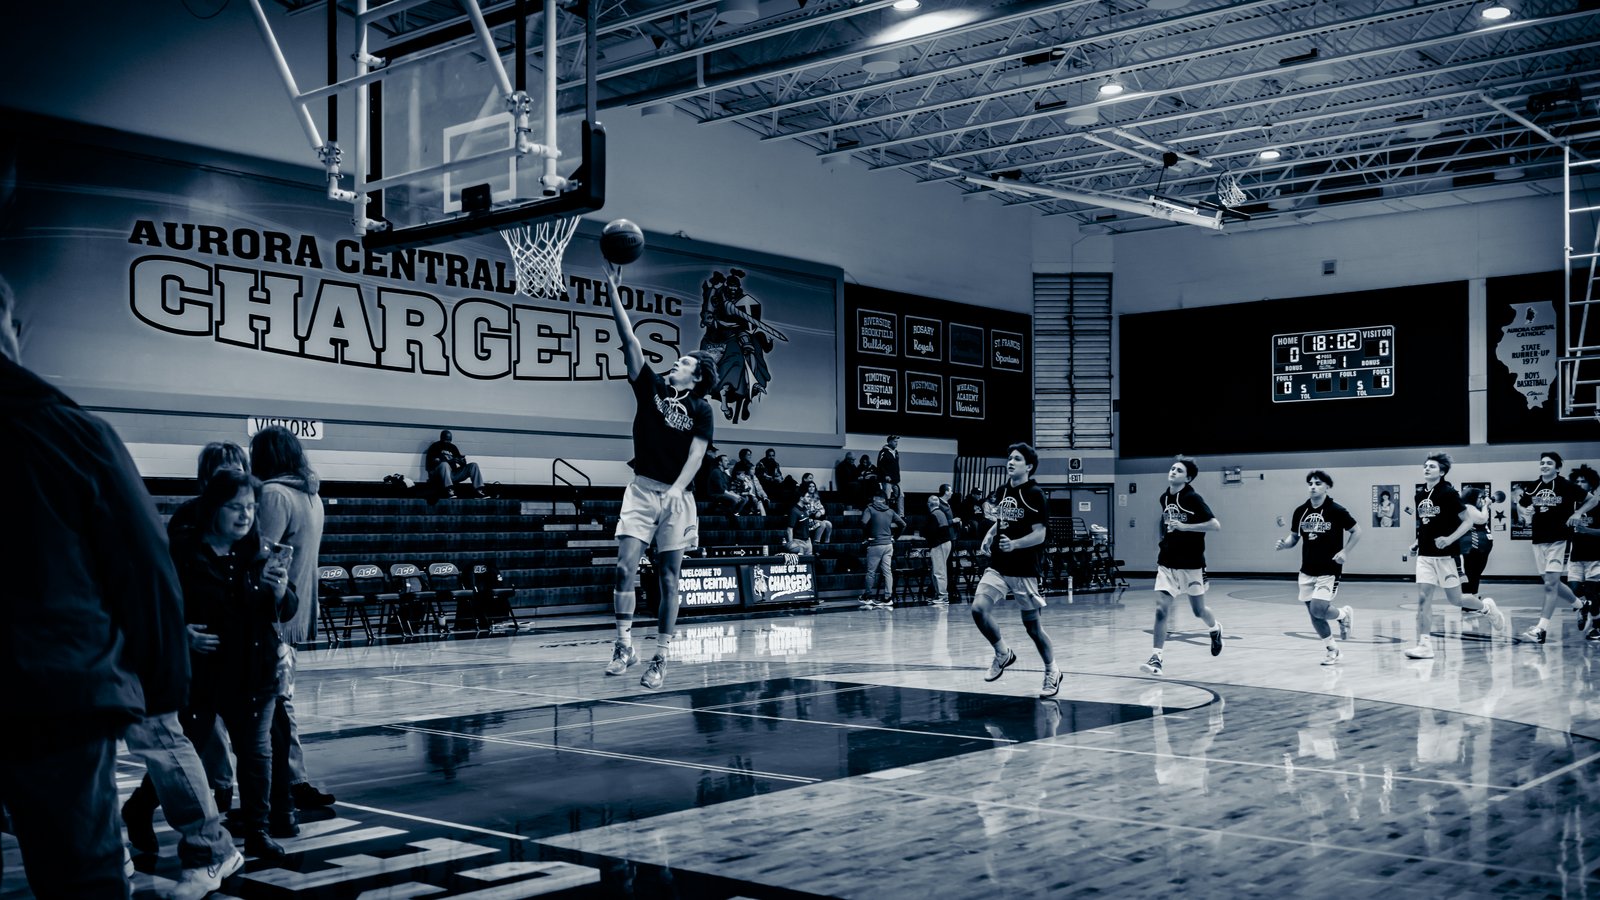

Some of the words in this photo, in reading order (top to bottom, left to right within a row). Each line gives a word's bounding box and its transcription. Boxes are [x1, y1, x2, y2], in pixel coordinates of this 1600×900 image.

[128, 219, 322, 269] AURORA
[336, 239, 516, 294] CENTRAL
[527, 267, 682, 316] CATHOLIC
[129, 254, 681, 381] CHARGERS
[864, 317, 891, 329] RIVERSIDE
[861, 327, 893, 339] BROOKFIELD
[913, 325, 934, 335] ROSARY
[1363, 329, 1392, 338] VISITOR
[863, 337, 892, 354] Bulldogs
[913, 339, 934, 354] Royals
[1002, 339, 1020, 350] FRANCIS
[1278, 337, 1298, 345] HOME
[1312, 333, 1356, 351] 18:02
[1379, 340, 1389, 356] 0
[996, 351, 1019, 364] Spartans
[1290, 347, 1299, 362] 0
[1512, 350, 1550, 358] RUNNER-UP
[865, 373, 890, 383] TIMOTHY
[1381, 375, 1389, 388] 0
[1517, 379, 1547, 387] BASKETBALL
[863, 384, 893, 394] CHRISTIAN
[911, 381, 938, 392] WESTMONT
[1284, 382, 1292, 394] 0
[865, 393, 891, 409] Trojans
[957, 393, 979, 401] ACADEMY
[321, 569, 343, 578] ACC
[357, 567, 378, 577] ACC
[395, 566, 415, 576] ACC
[434, 566, 453, 574] ACC
[474, 565, 487, 573] AC
[681, 569, 712, 577] WELCOME
[713, 568, 721, 576] TO
[770, 566, 787, 574] HOME
[788, 565, 796, 573] OF
[796, 564, 807, 572] THE
[678, 578, 701, 591] RORA
[703, 577, 738, 590] CENTRAL
[769, 574, 812, 591] CHARGERS
[686, 591, 724, 605] CATHOLIC
